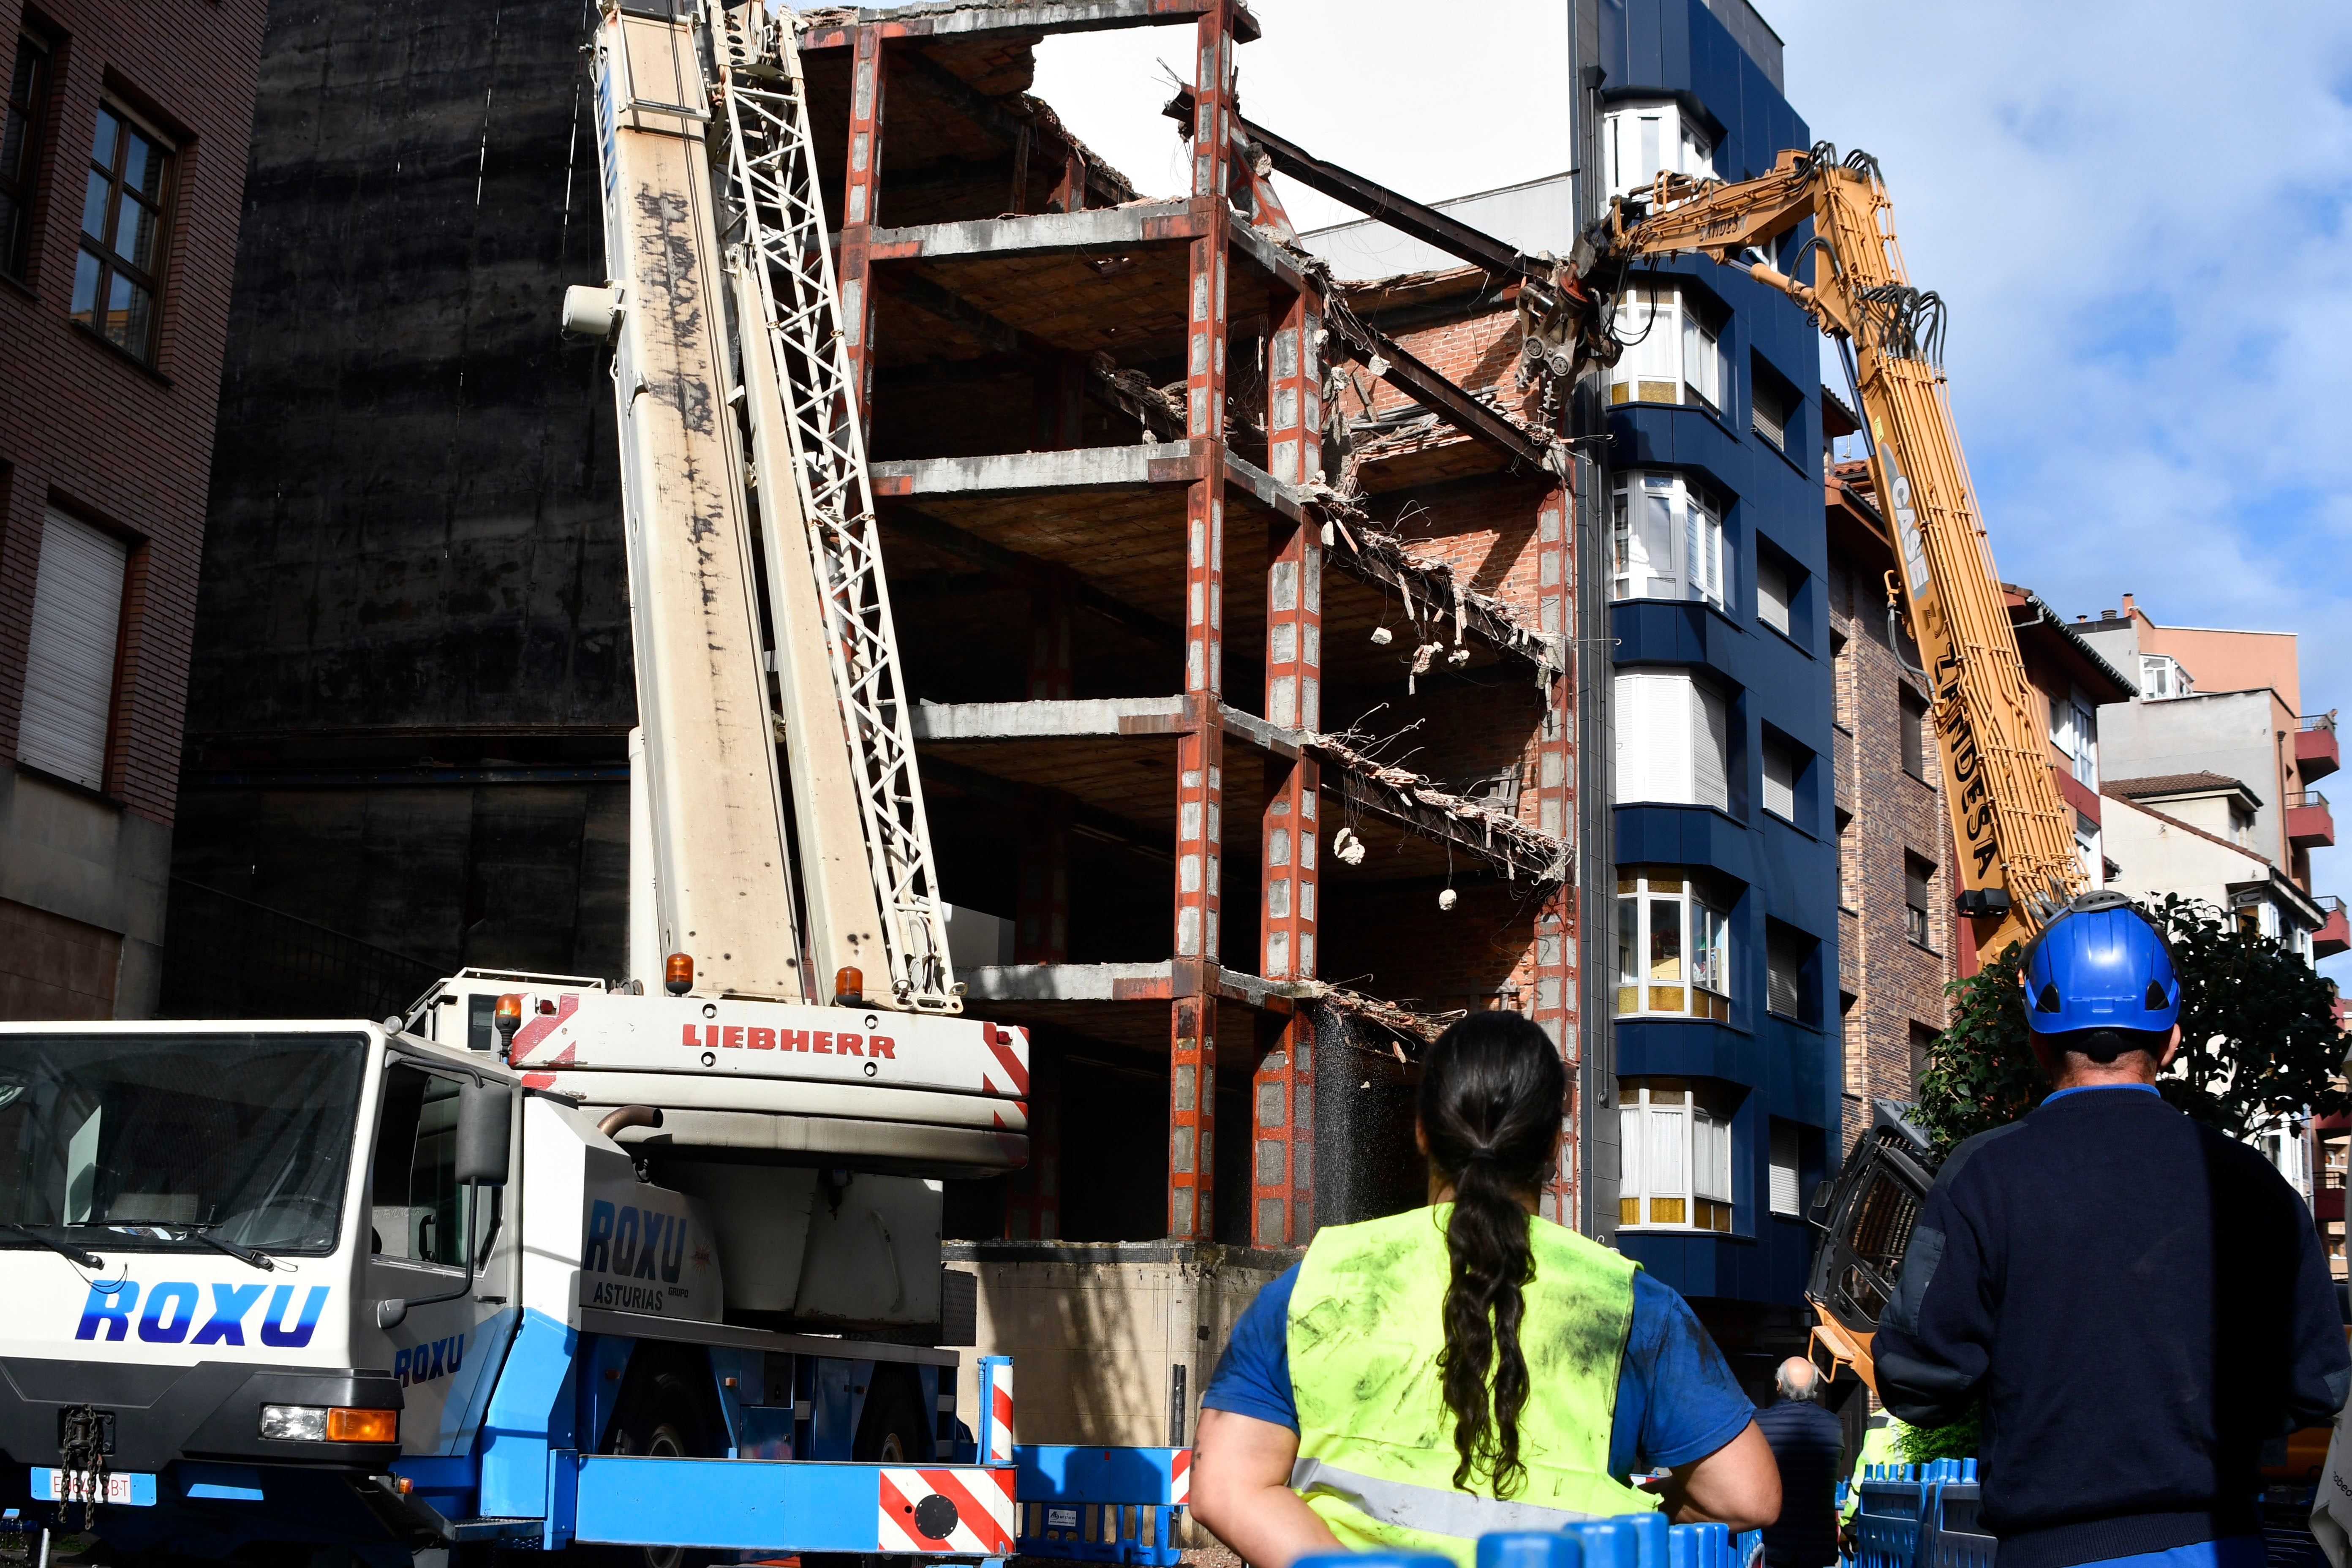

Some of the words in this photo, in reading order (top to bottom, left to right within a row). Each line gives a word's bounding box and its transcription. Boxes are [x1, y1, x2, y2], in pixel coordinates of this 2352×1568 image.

[1892, 476, 1930, 591] CASE
[1934, 641, 1997, 880] ZANDESA
[682, 1024, 896, 1059] LIEBHERR
[583, 1199, 687, 1284] ROXU
[74, 1279, 331, 1348] ROXU
[593, 1282, 663, 1311] ASTURIAS
[668, 1287, 689, 1298] GRUPO
[394, 1334, 464, 1388] ROXU
